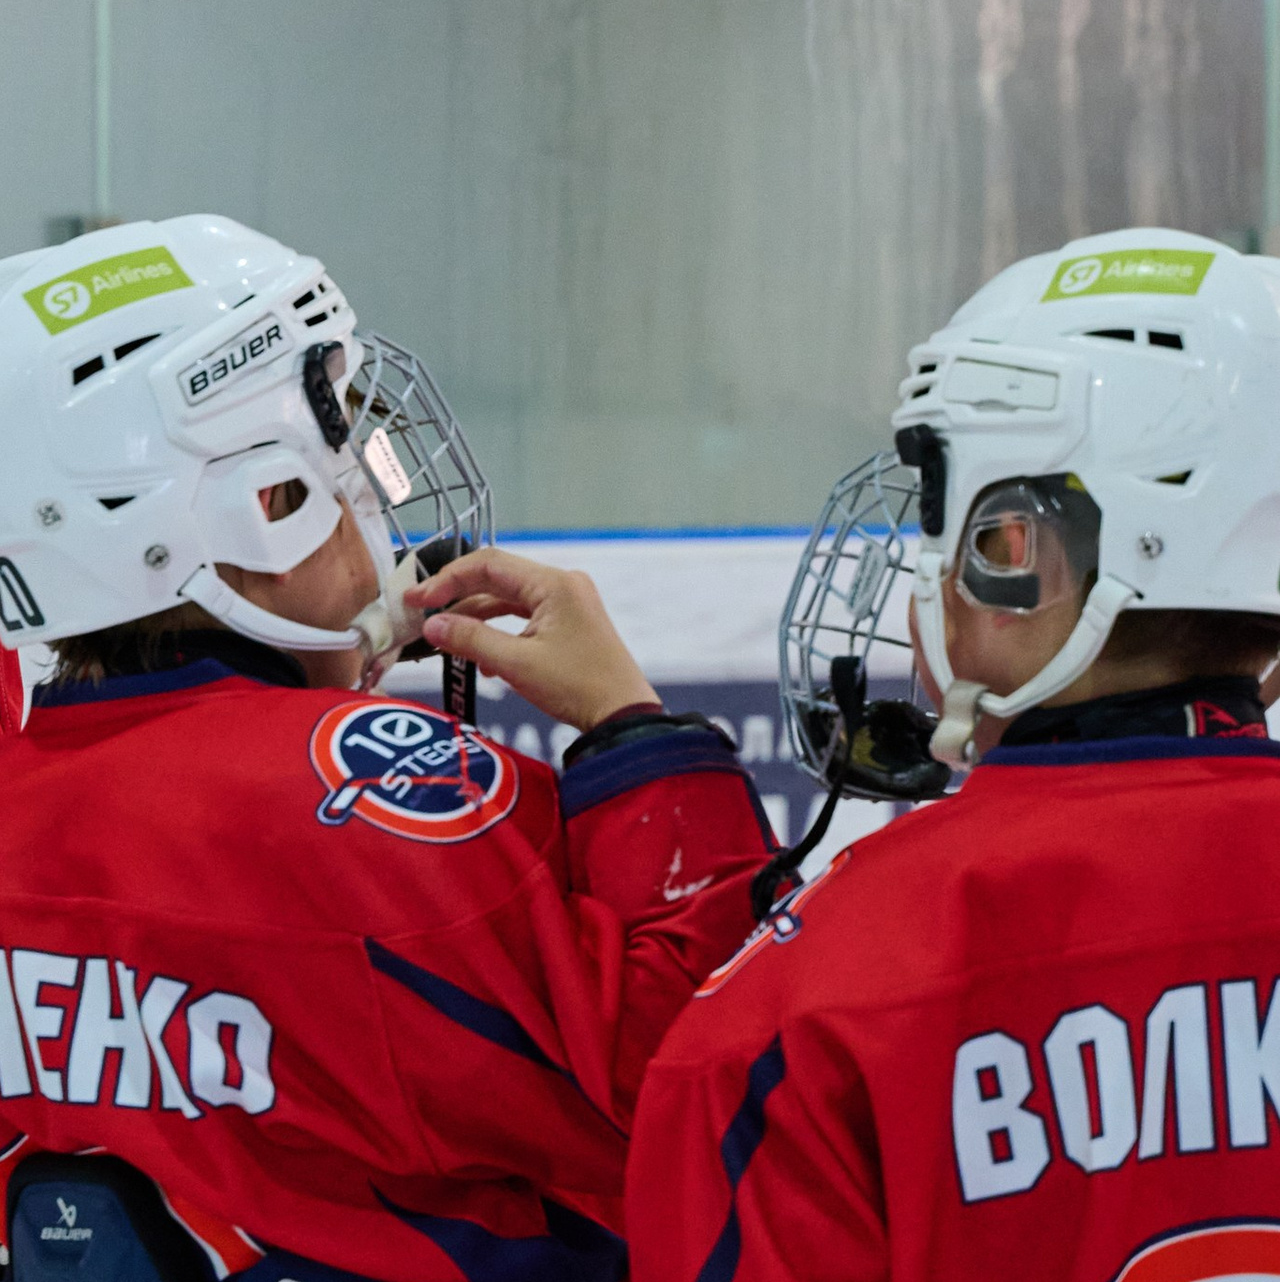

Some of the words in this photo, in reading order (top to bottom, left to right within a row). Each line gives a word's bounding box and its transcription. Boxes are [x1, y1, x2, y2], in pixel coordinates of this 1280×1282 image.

[92, 262, 173, 295] Airlines
[188, 324, 283, 396] BAUER
[344, 712, 433, 759] 10
